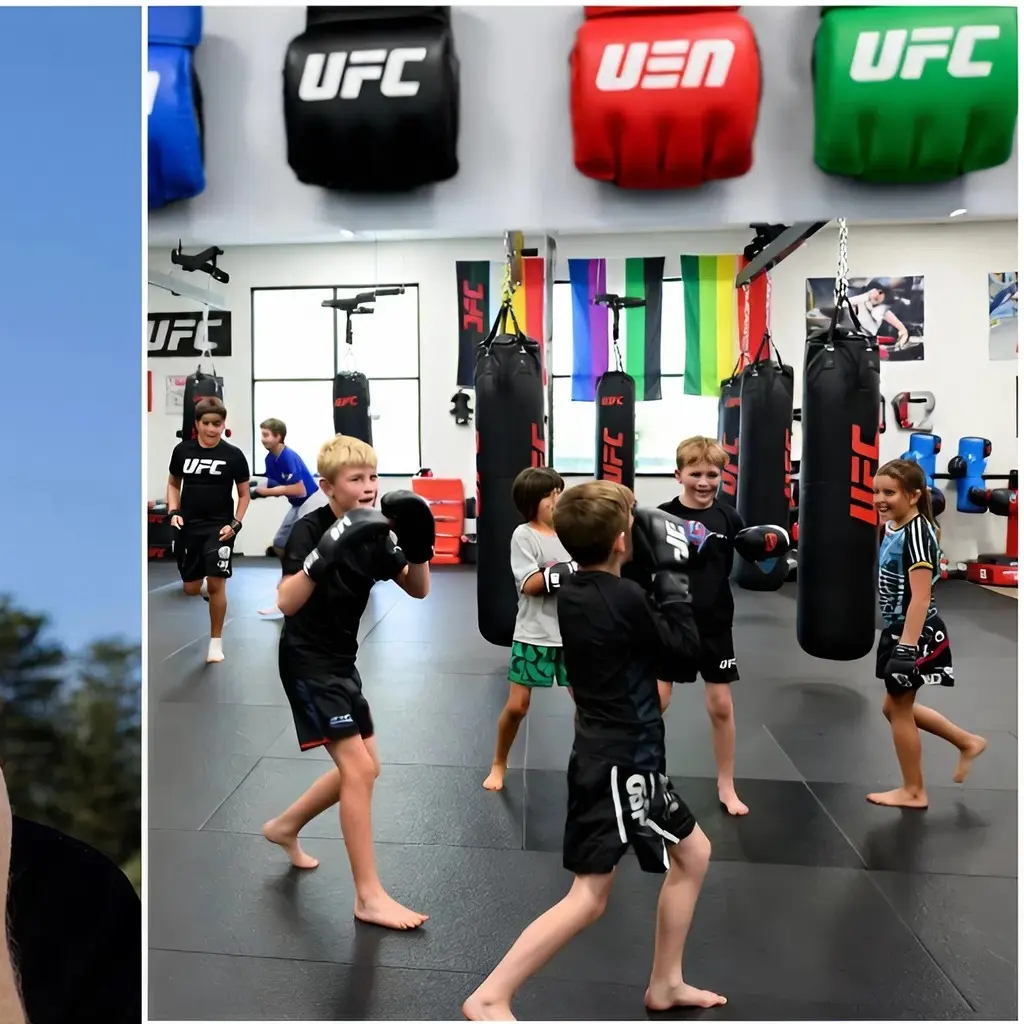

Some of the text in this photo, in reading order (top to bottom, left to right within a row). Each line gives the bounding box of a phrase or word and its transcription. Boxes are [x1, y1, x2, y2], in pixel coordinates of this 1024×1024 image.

[298, 47, 426, 101] UFC
[849, 25, 1001, 82] UFC
[183, 458, 227, 475] UFC
[603, 427, 624, 485] UFC
[850, 423, 880, 526] UFC
